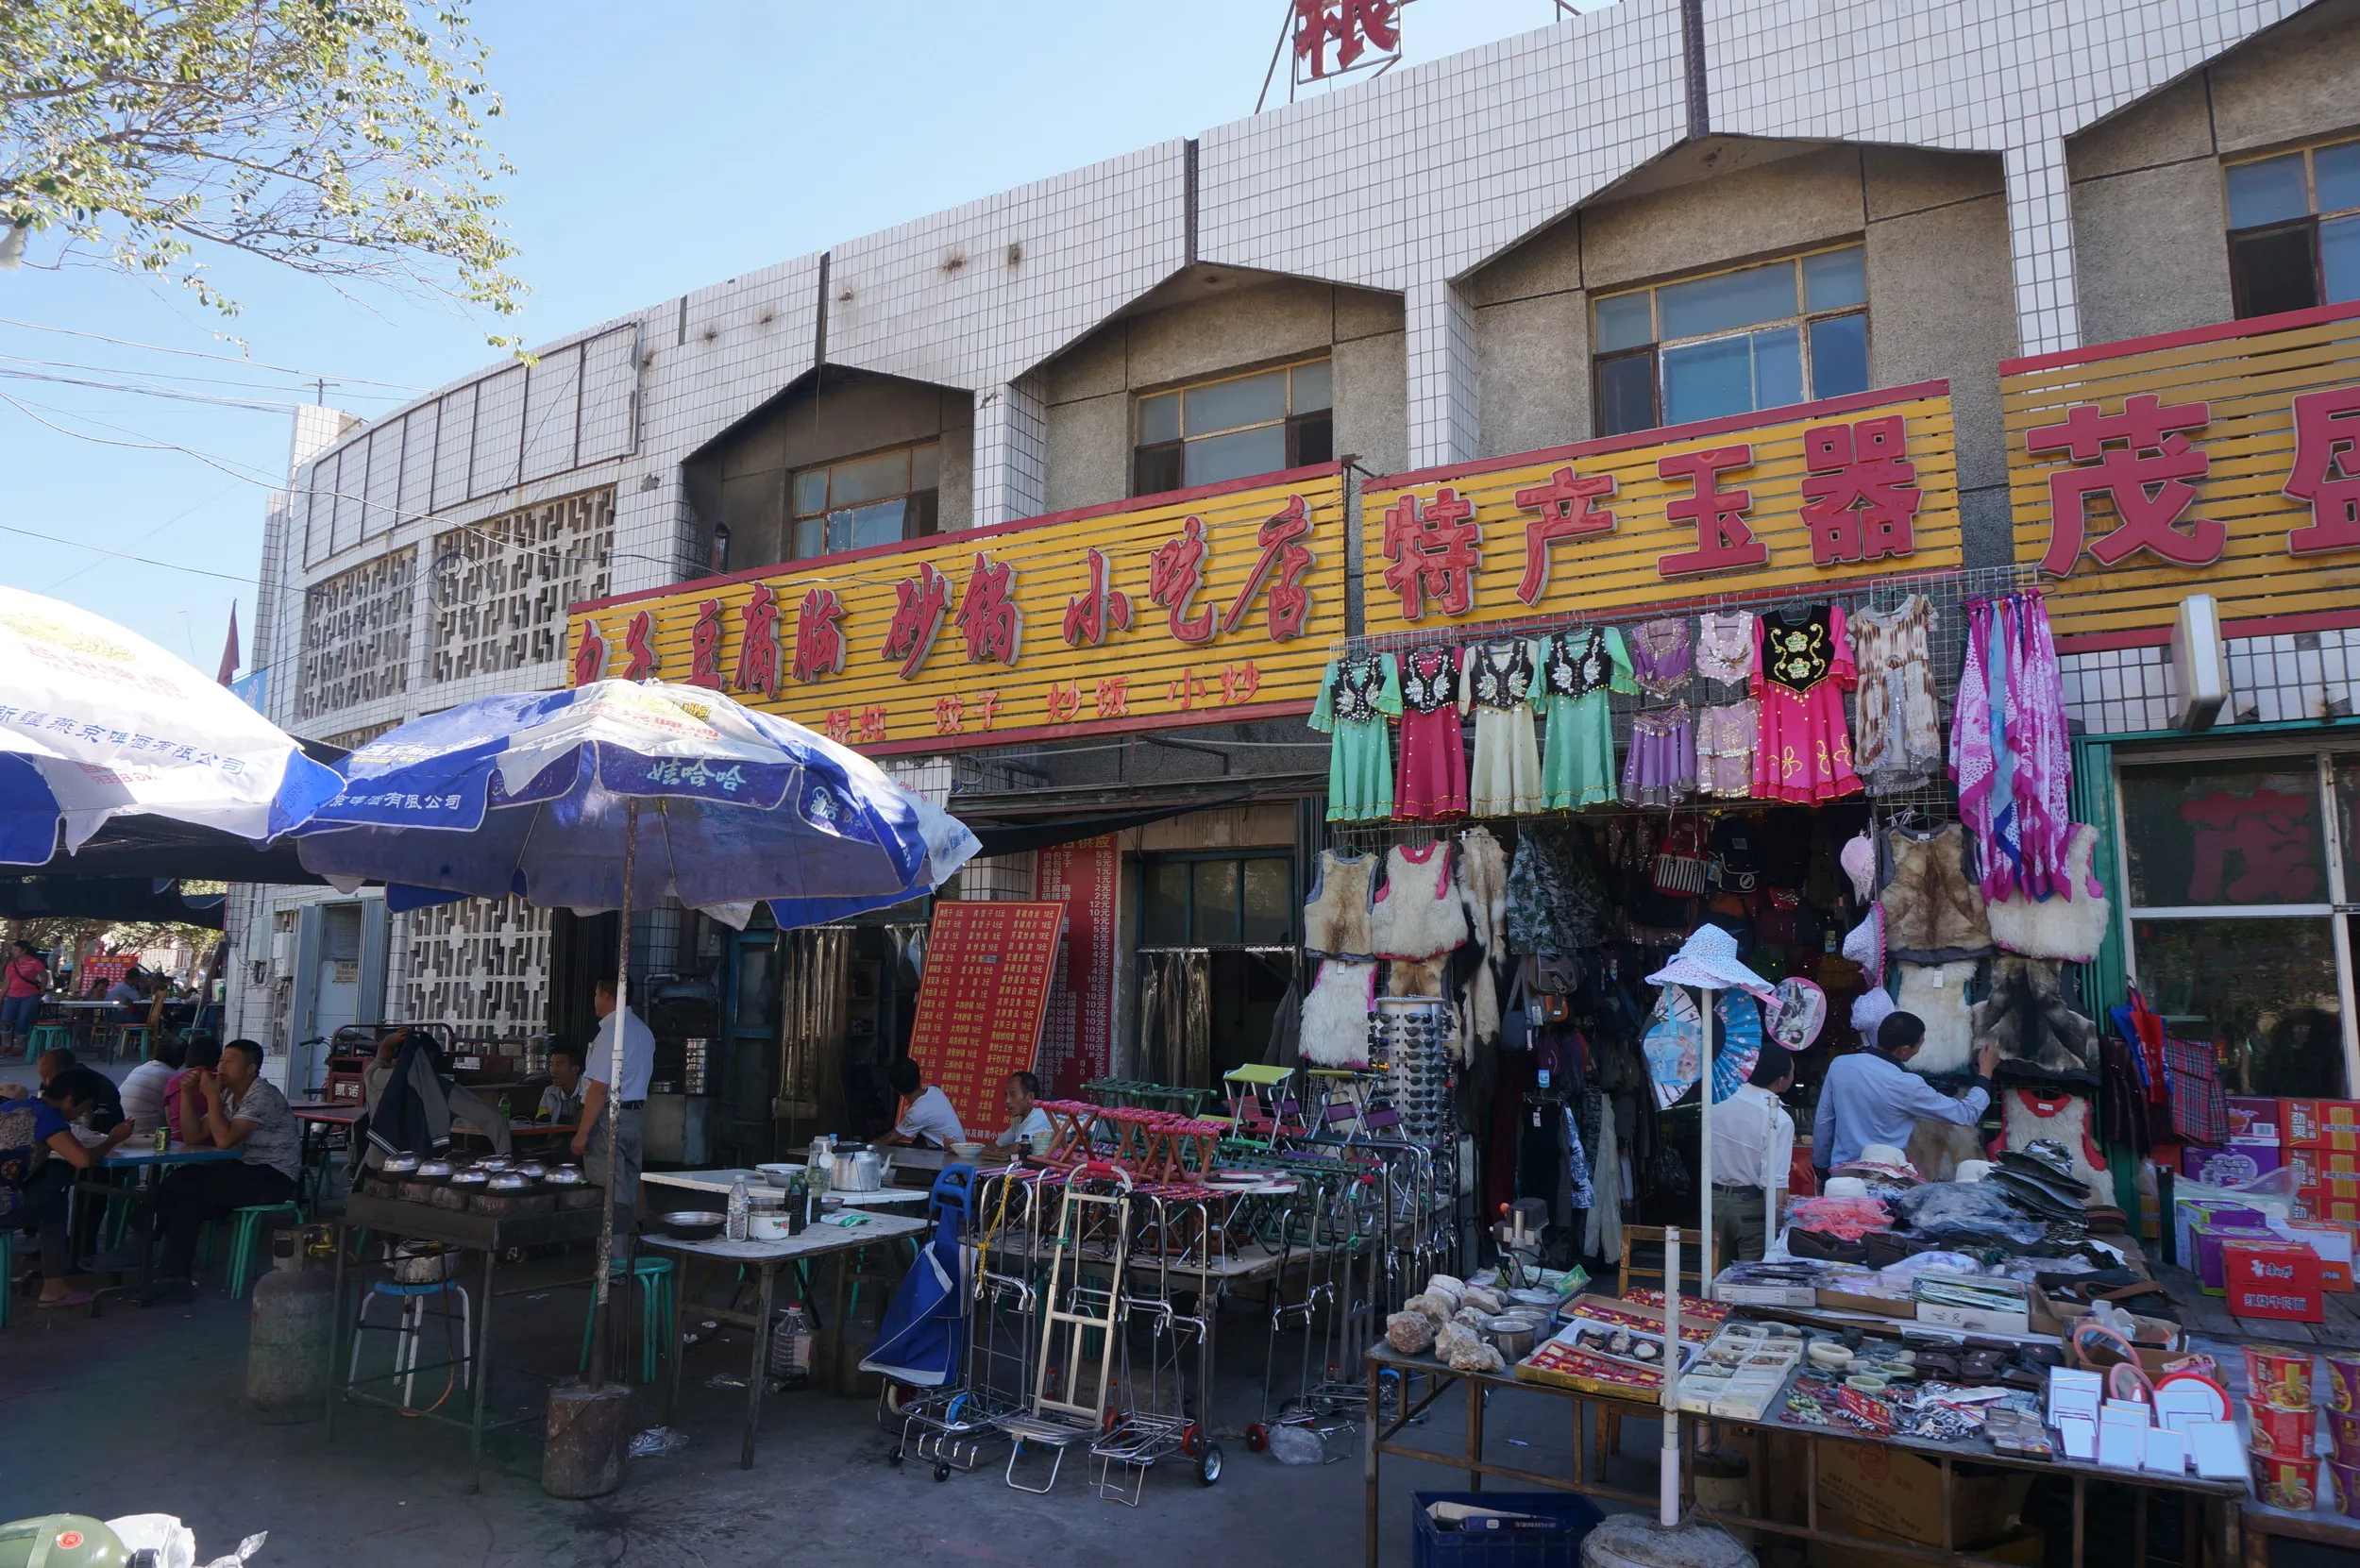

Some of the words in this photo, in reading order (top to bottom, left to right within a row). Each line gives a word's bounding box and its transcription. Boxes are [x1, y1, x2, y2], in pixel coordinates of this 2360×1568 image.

[1382, 413, 1922, 621] 特产玉器
[1064, 493, 1315, 648] 小吃店
[935, 692, 1003, 735] 饺子
[1046, 676, 1131, 723] 炒饭
[1166, 661, 1262, 709] 小炒
[0, 706, 246, 774] 新疆燕京啤酒有限公司
[647, 757, 747, 792] 娃哈哈
[1043, 851, 1071, 860] 肉包子
[1096, 851, 1112, 859] 5元
[1096, 875, 1111, 884] 1元
[1041, 885, 1070, 893] 豆腐脑
[1089, 908, 1110, 917] 10元
[1093, 917, 1110, 925] 5元
[1093, 925, 1109, 934] 5元
[1092, 958, 1108, 967] 3元
[1091, 967, 1108, 975] 4元
[1087, 975, 1107, 984] 10元
[1091, 984, 1107, 992] 8元
[988, 1042, 1013, 1053] 炒土豆丝
[335, 1083, 359, 1098] 凯诺
